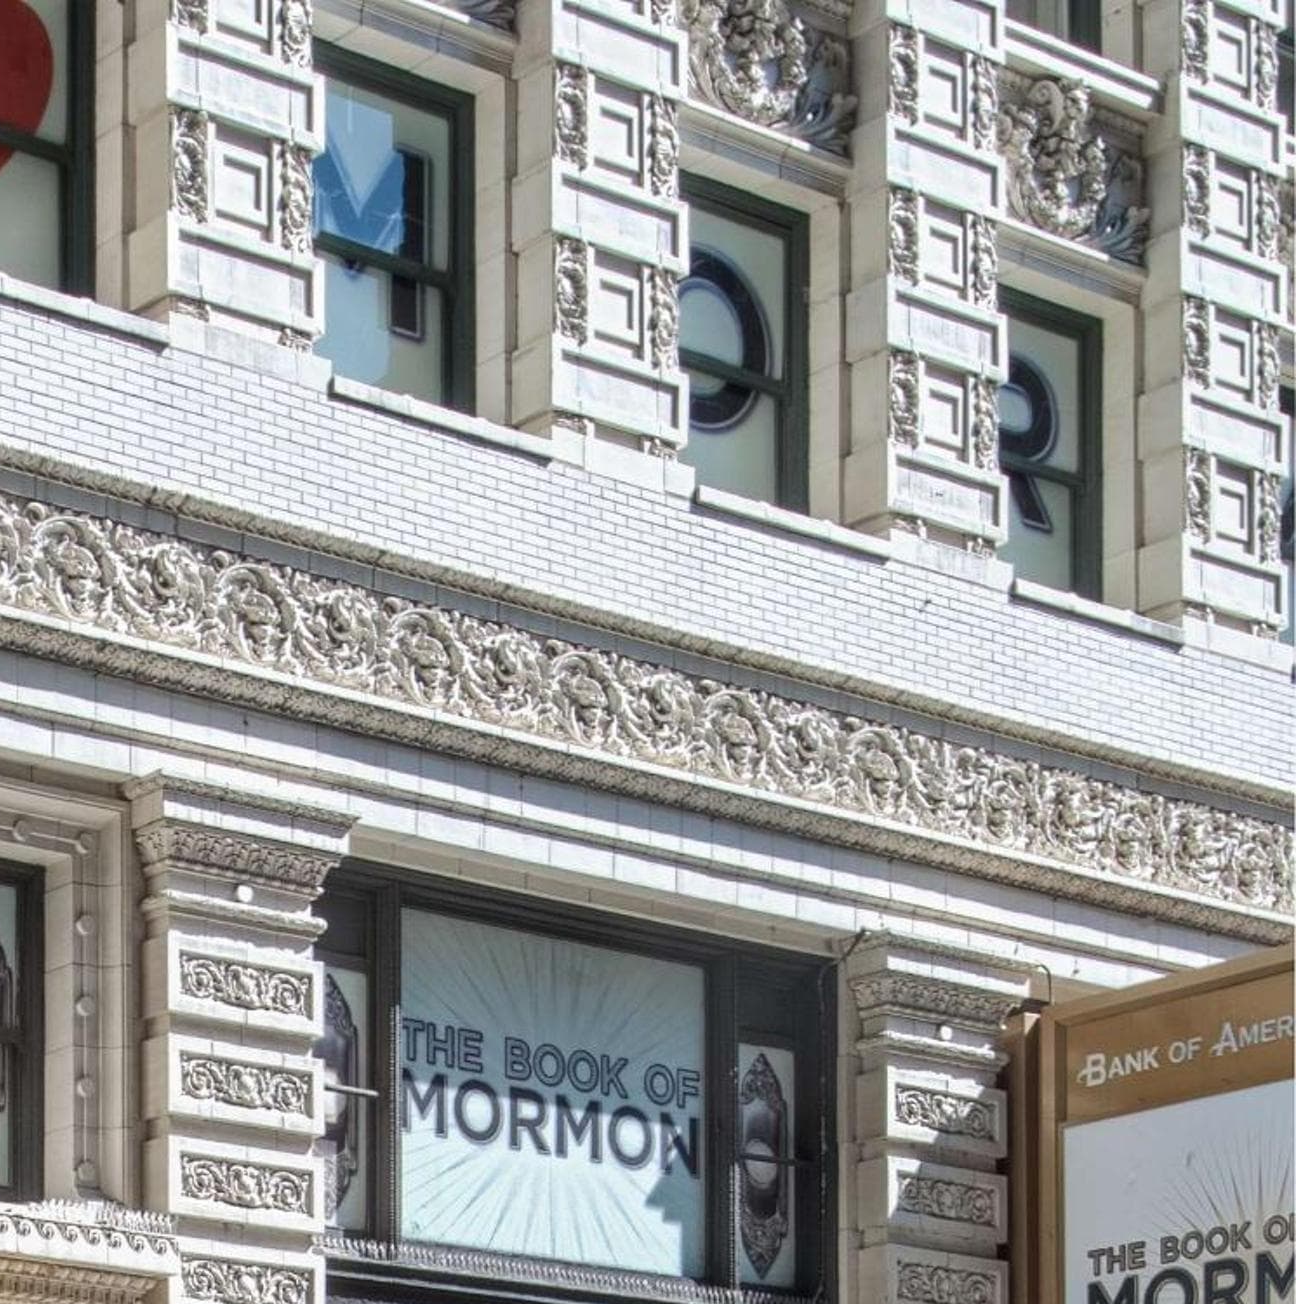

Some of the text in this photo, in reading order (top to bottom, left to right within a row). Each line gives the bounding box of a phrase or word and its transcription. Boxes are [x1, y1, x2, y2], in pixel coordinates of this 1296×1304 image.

[402, 1018, 700, 1108] THE BOOK OF
[401, 1067, 700, 1180] MORMON
[1088, 1241, 1146, 1277] THE
[1160, 1221, 1252, 1264] BOOK
